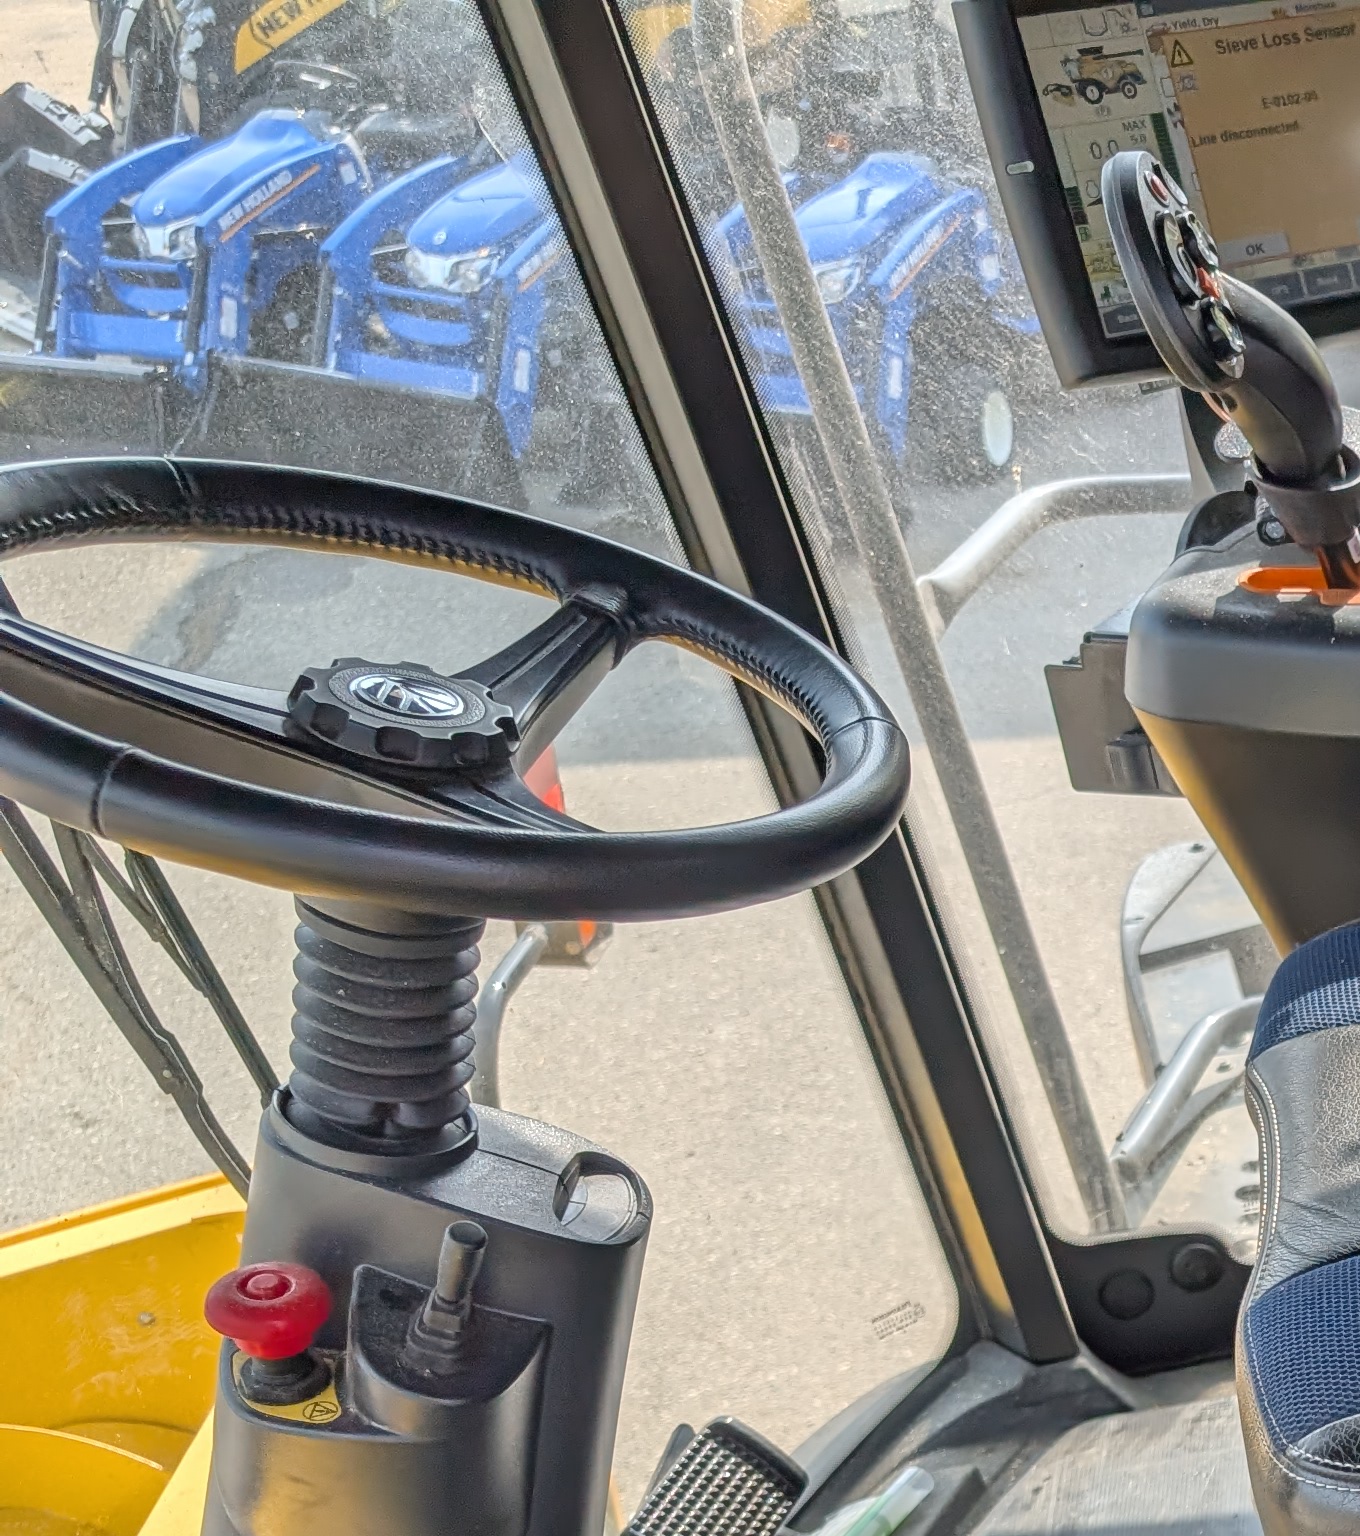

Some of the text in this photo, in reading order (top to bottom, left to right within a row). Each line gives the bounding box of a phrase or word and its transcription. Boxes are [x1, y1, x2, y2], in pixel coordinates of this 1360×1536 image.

[1215, 22, 1356, 55] Sieve Loss Sensor
[1122, 119, 1147, 132] MAX
[1190, 133, 1218, 149] Line
[1245, 242, 1266, 257] OK
